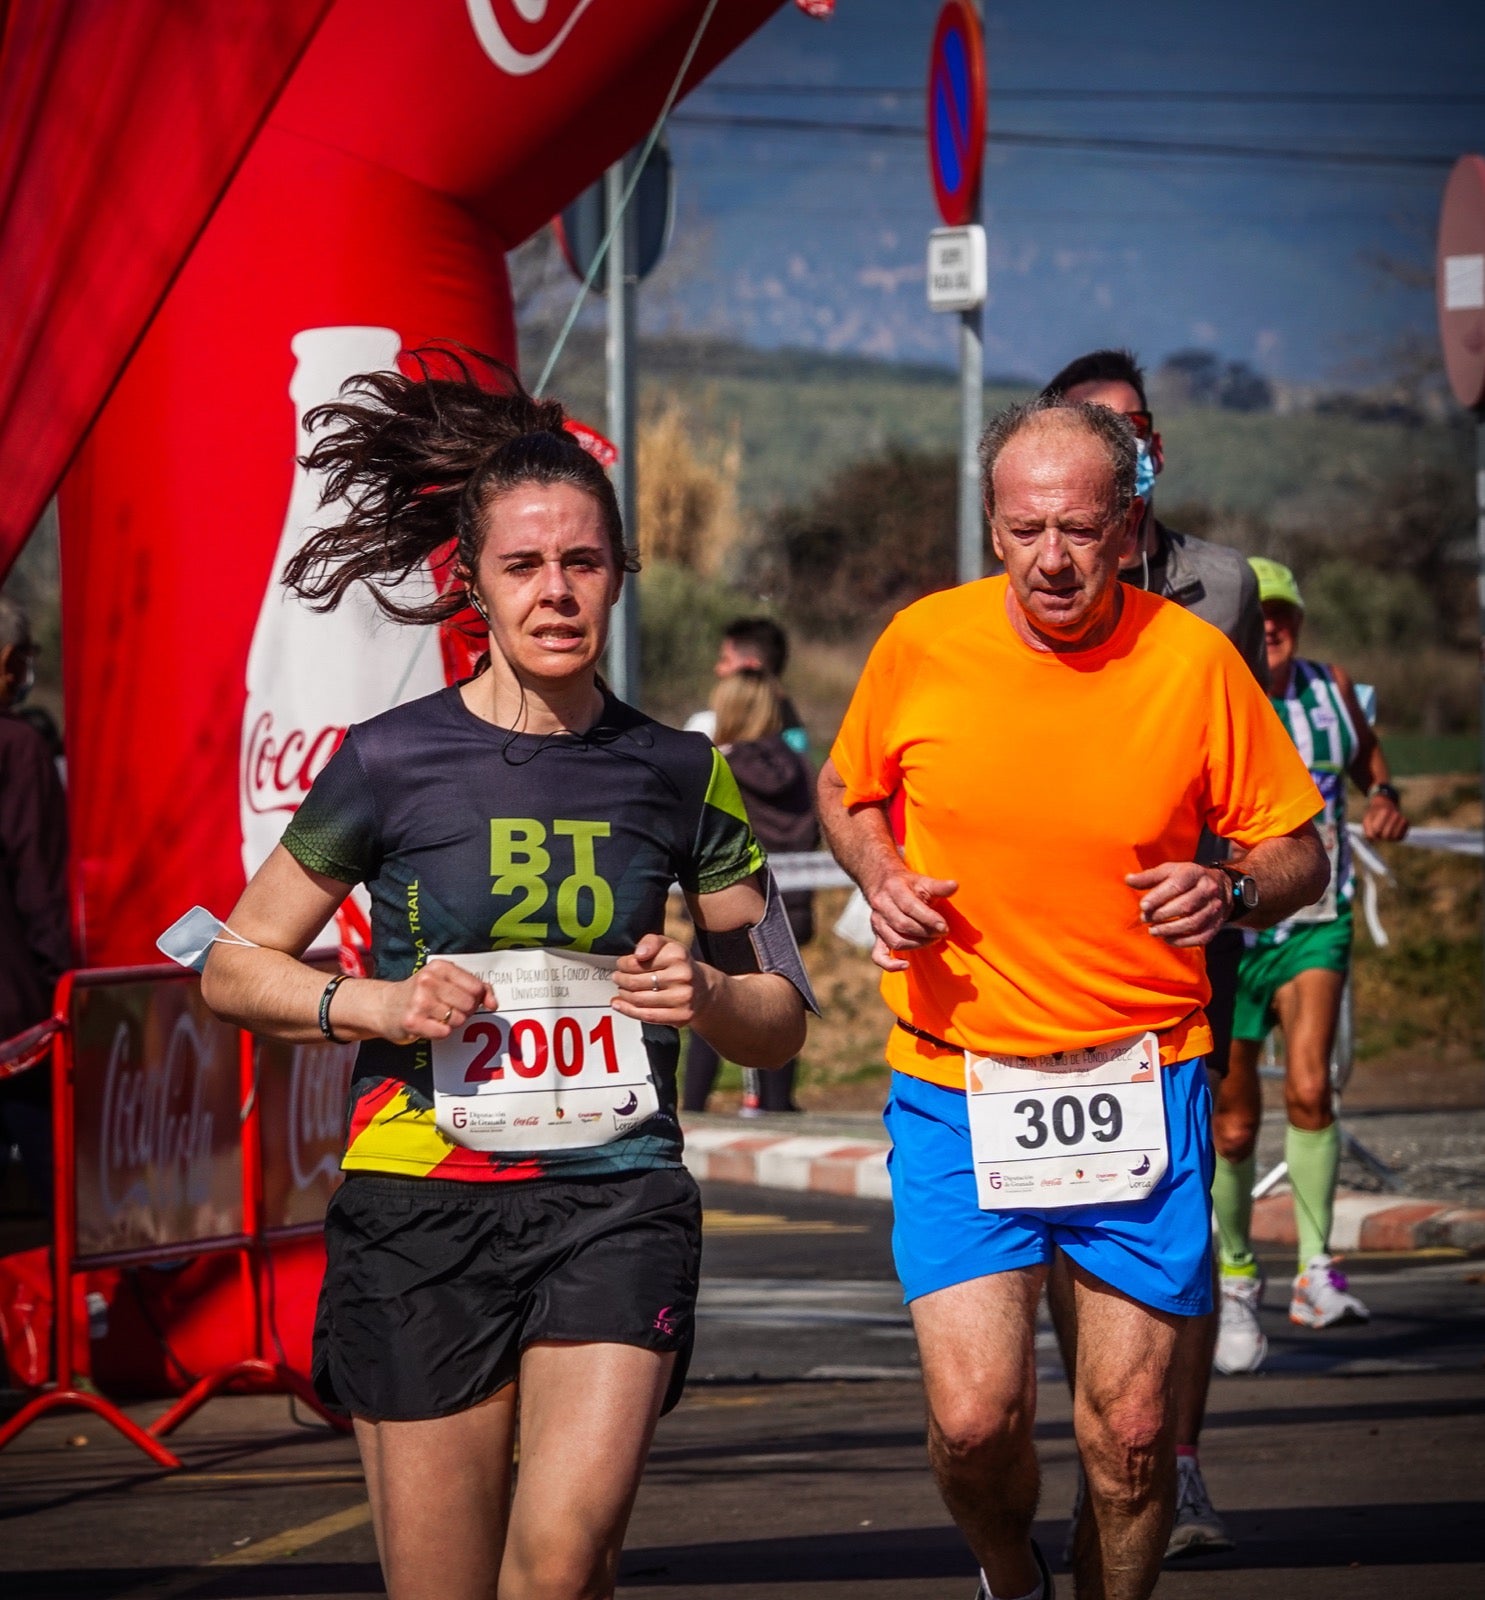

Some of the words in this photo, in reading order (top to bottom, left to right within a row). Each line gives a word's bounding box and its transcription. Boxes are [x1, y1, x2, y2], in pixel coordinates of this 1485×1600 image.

[490, 818, 611, 876] BT
[407, 879, 421, 934] TRAIL
[490, 874, 614, 939] 20
[511, 986, 550, 1000] UNIVERSO
[516, 967, 550, 983] PREMIO
[551, 968, 561, 982] DE
[562, 964, 590, 982] FONDO
[592, 965, 613, 982] 202
[462, 1015, 620, 1083] 2001
[1014, 1093, 1123, 1150] 309
